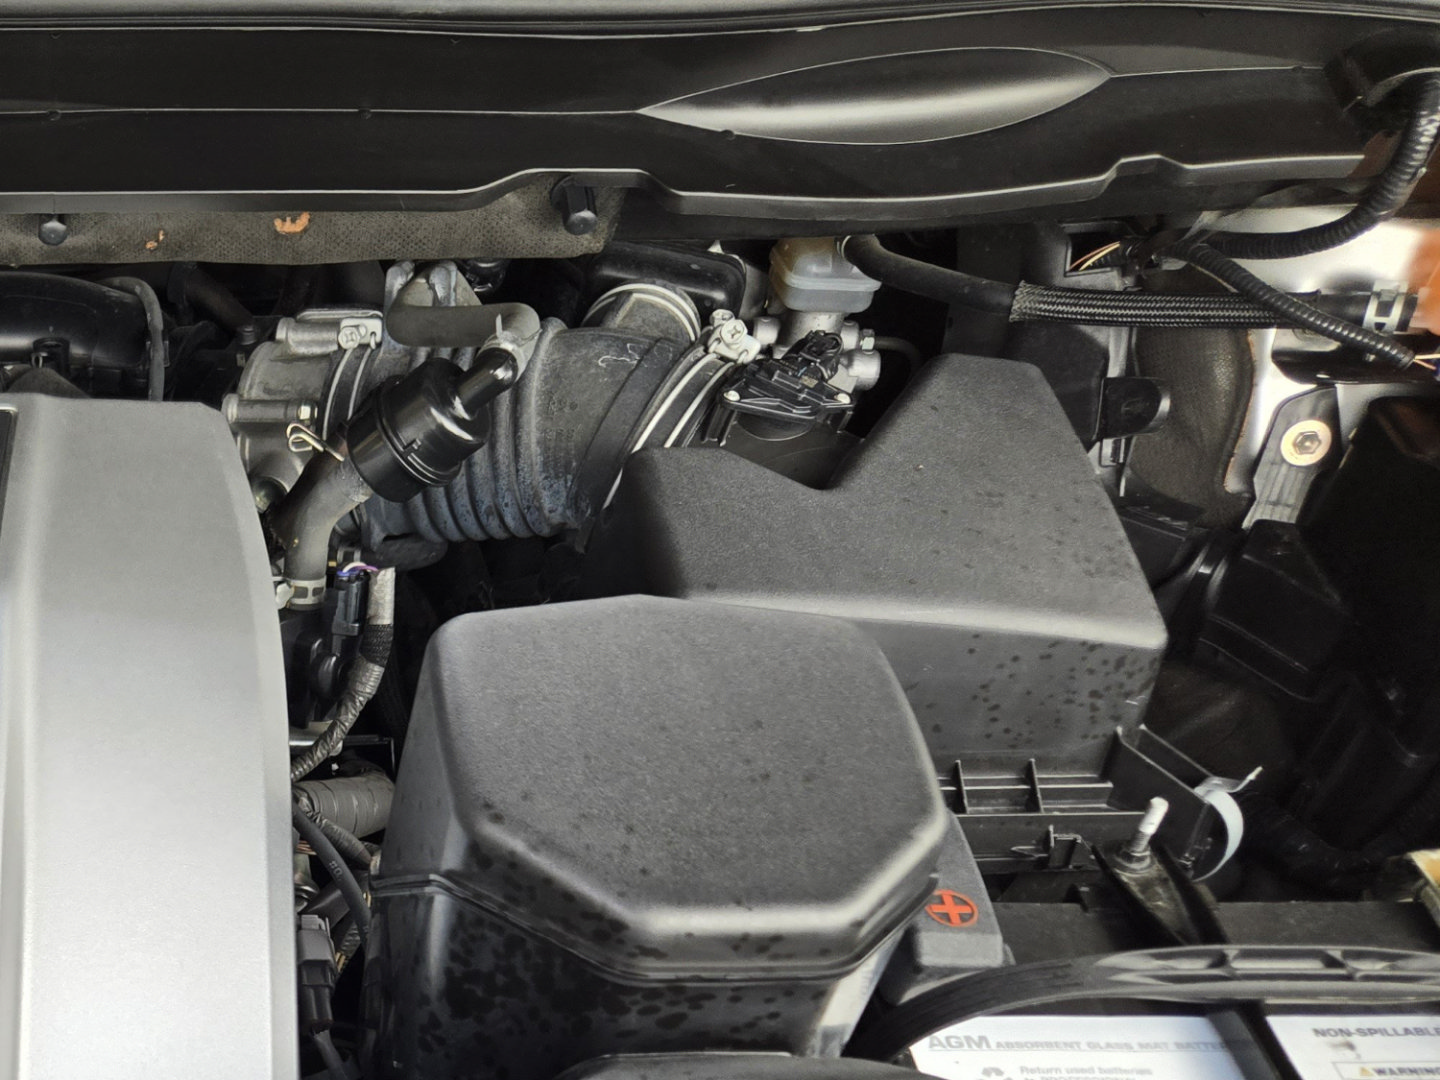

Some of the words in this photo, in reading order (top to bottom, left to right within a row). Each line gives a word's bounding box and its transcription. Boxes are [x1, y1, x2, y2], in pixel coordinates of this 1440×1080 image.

[928, 1035, 992, 1049] AGM
[995, 1041, 1082, 1050] ABSORBENT
[1019, 1065, 1062, 1075] Return
[1064, 1065, 1095, 1075] used
